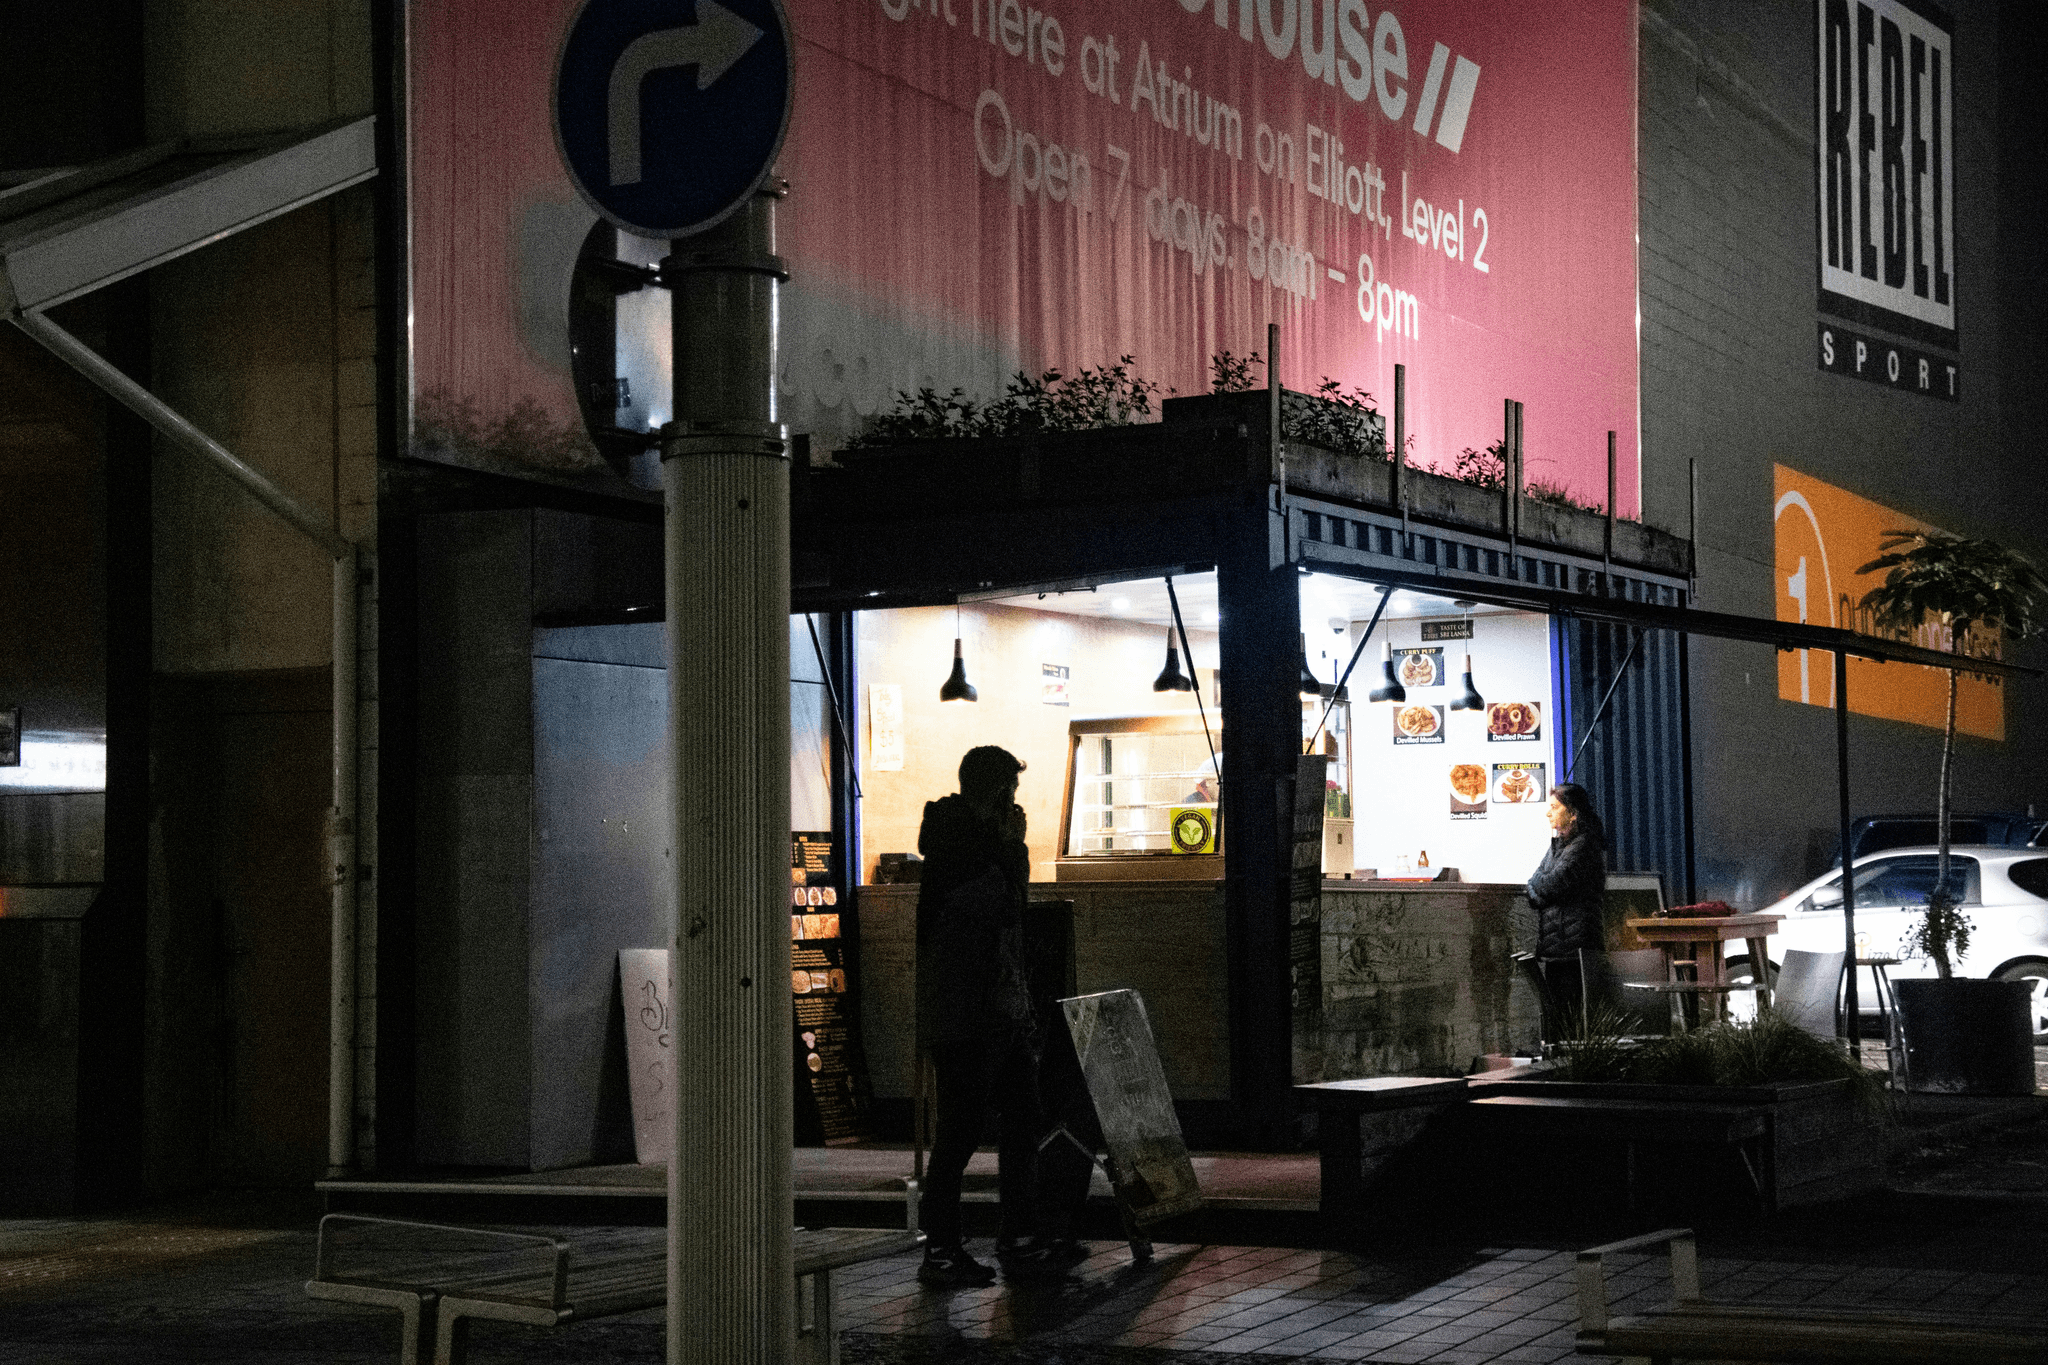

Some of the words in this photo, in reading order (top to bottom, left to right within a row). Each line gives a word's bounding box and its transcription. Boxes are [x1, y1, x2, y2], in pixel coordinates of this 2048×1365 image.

[974, 89, 1092, 213] Open
[1106, 142, 1131, 223] 7
[1148, 167, 1235, 276] days.
[1248, 206, 1317, 301] 8am
[1357, 253, 1419, 343] 8pm
[1080, 33, 1121, 105] at
[1131, 40, 1243, 161] Atrium
[1256, 121, 1297, 185] on
[1305, 124, 1392, 241] Elliott,
[1402, 171, 1465, 262] Level
[1472, 208, 1490, 274] 2
[1825, 0, 1951, 307] REBEL
[1822, 330, 1956, 397] SPORT
[1493, 734, 1516, 742] Devilled
